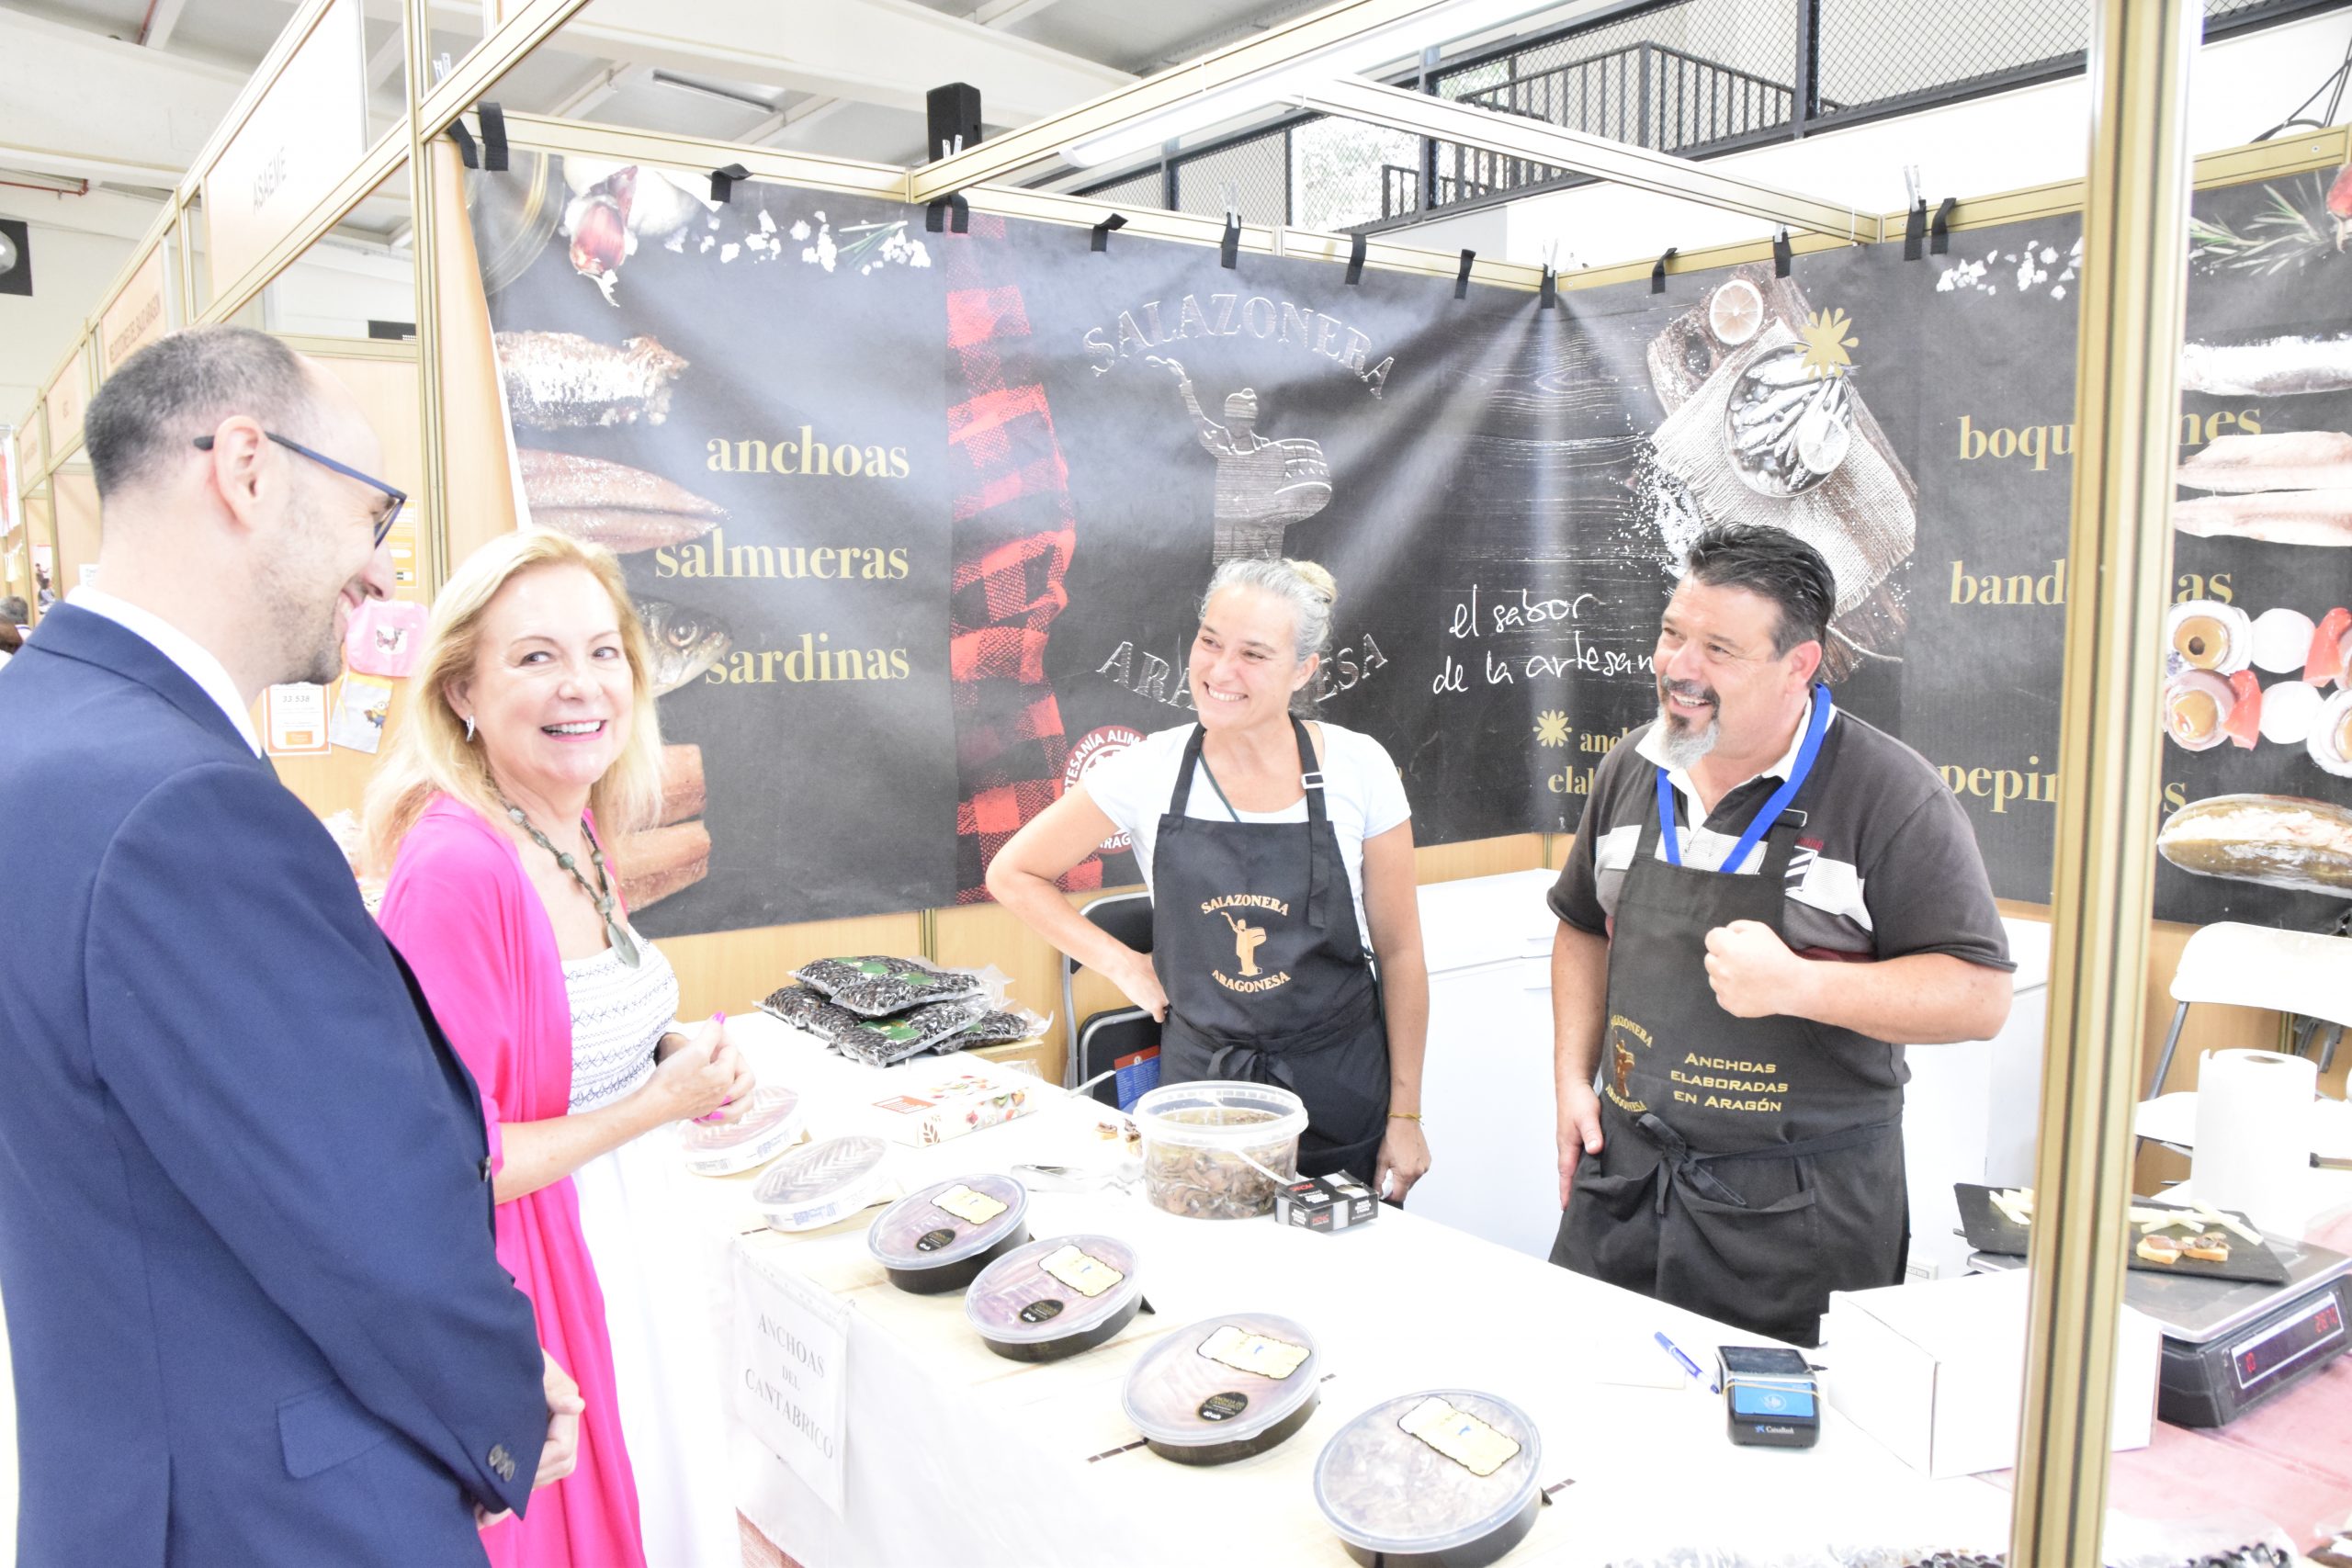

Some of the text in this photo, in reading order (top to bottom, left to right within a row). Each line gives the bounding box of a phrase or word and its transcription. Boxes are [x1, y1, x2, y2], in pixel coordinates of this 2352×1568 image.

[1083, 294, 1395, 400] SALAZONERA
[707, 425, 910, 479] anchoas
[655, 527, 909, 580] salmueras
[1449, 583, 1595, 638] el sabor
[706, 633, 910, 684] sardinas
[1095, 633, 1388, 711] ARAESA
[1432, 630, 1656, 694] de la artesan
[1201, 894, 1289, 917] SALAZONERA
[1211, 969, 1292, 993] ARAGONESA
[1670, 1070, 1789, 1093] ELABORADAS
[1684, 1053, 1777, 1074] ANCHOAS
[1673, 1090, 1782, 1112] EN ARAGÓN
[758, 1313, 825, 1378] ANCHOAS
[782, 1365, 800, 1392] DEL
[745, 1368, 834, 1460] CANTABRICO
